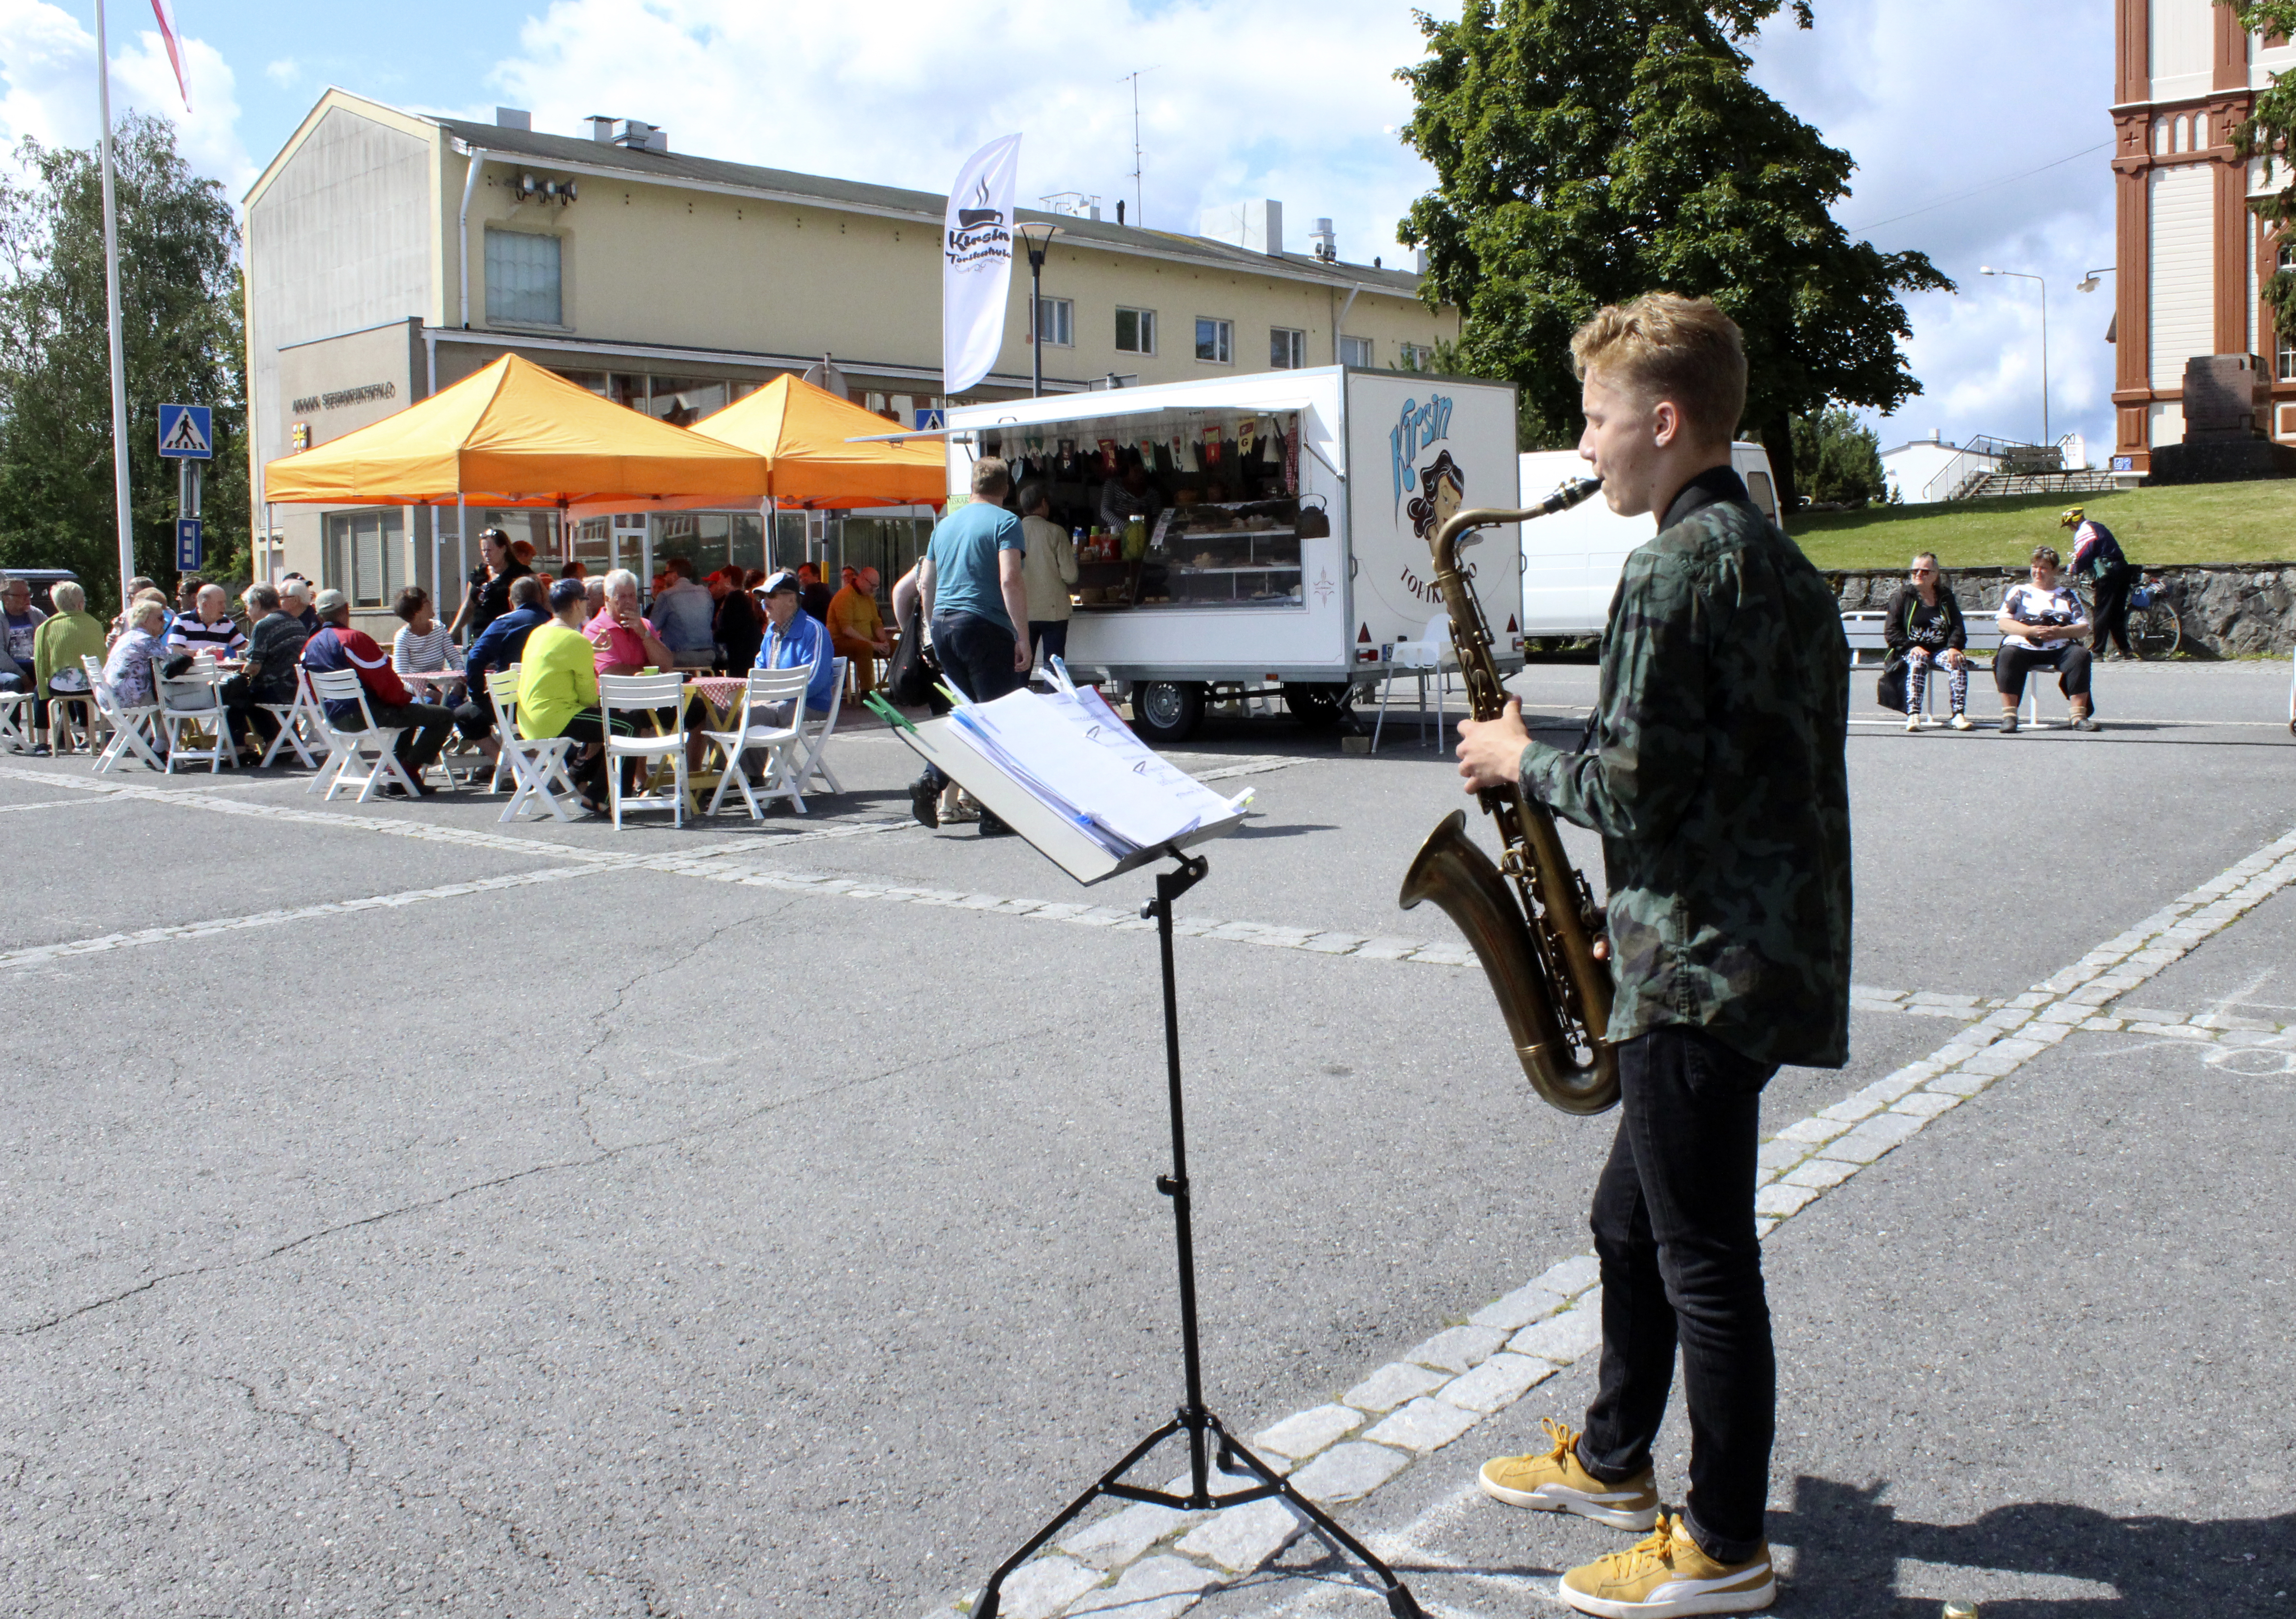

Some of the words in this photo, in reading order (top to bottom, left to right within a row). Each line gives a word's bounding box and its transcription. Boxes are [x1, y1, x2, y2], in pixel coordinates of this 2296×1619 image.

[949, 228, 1010, 251] Kirsin
[945, 247, 1011, 265] Torikahvio
[1389, 393, 1453, 532] Kirsin
